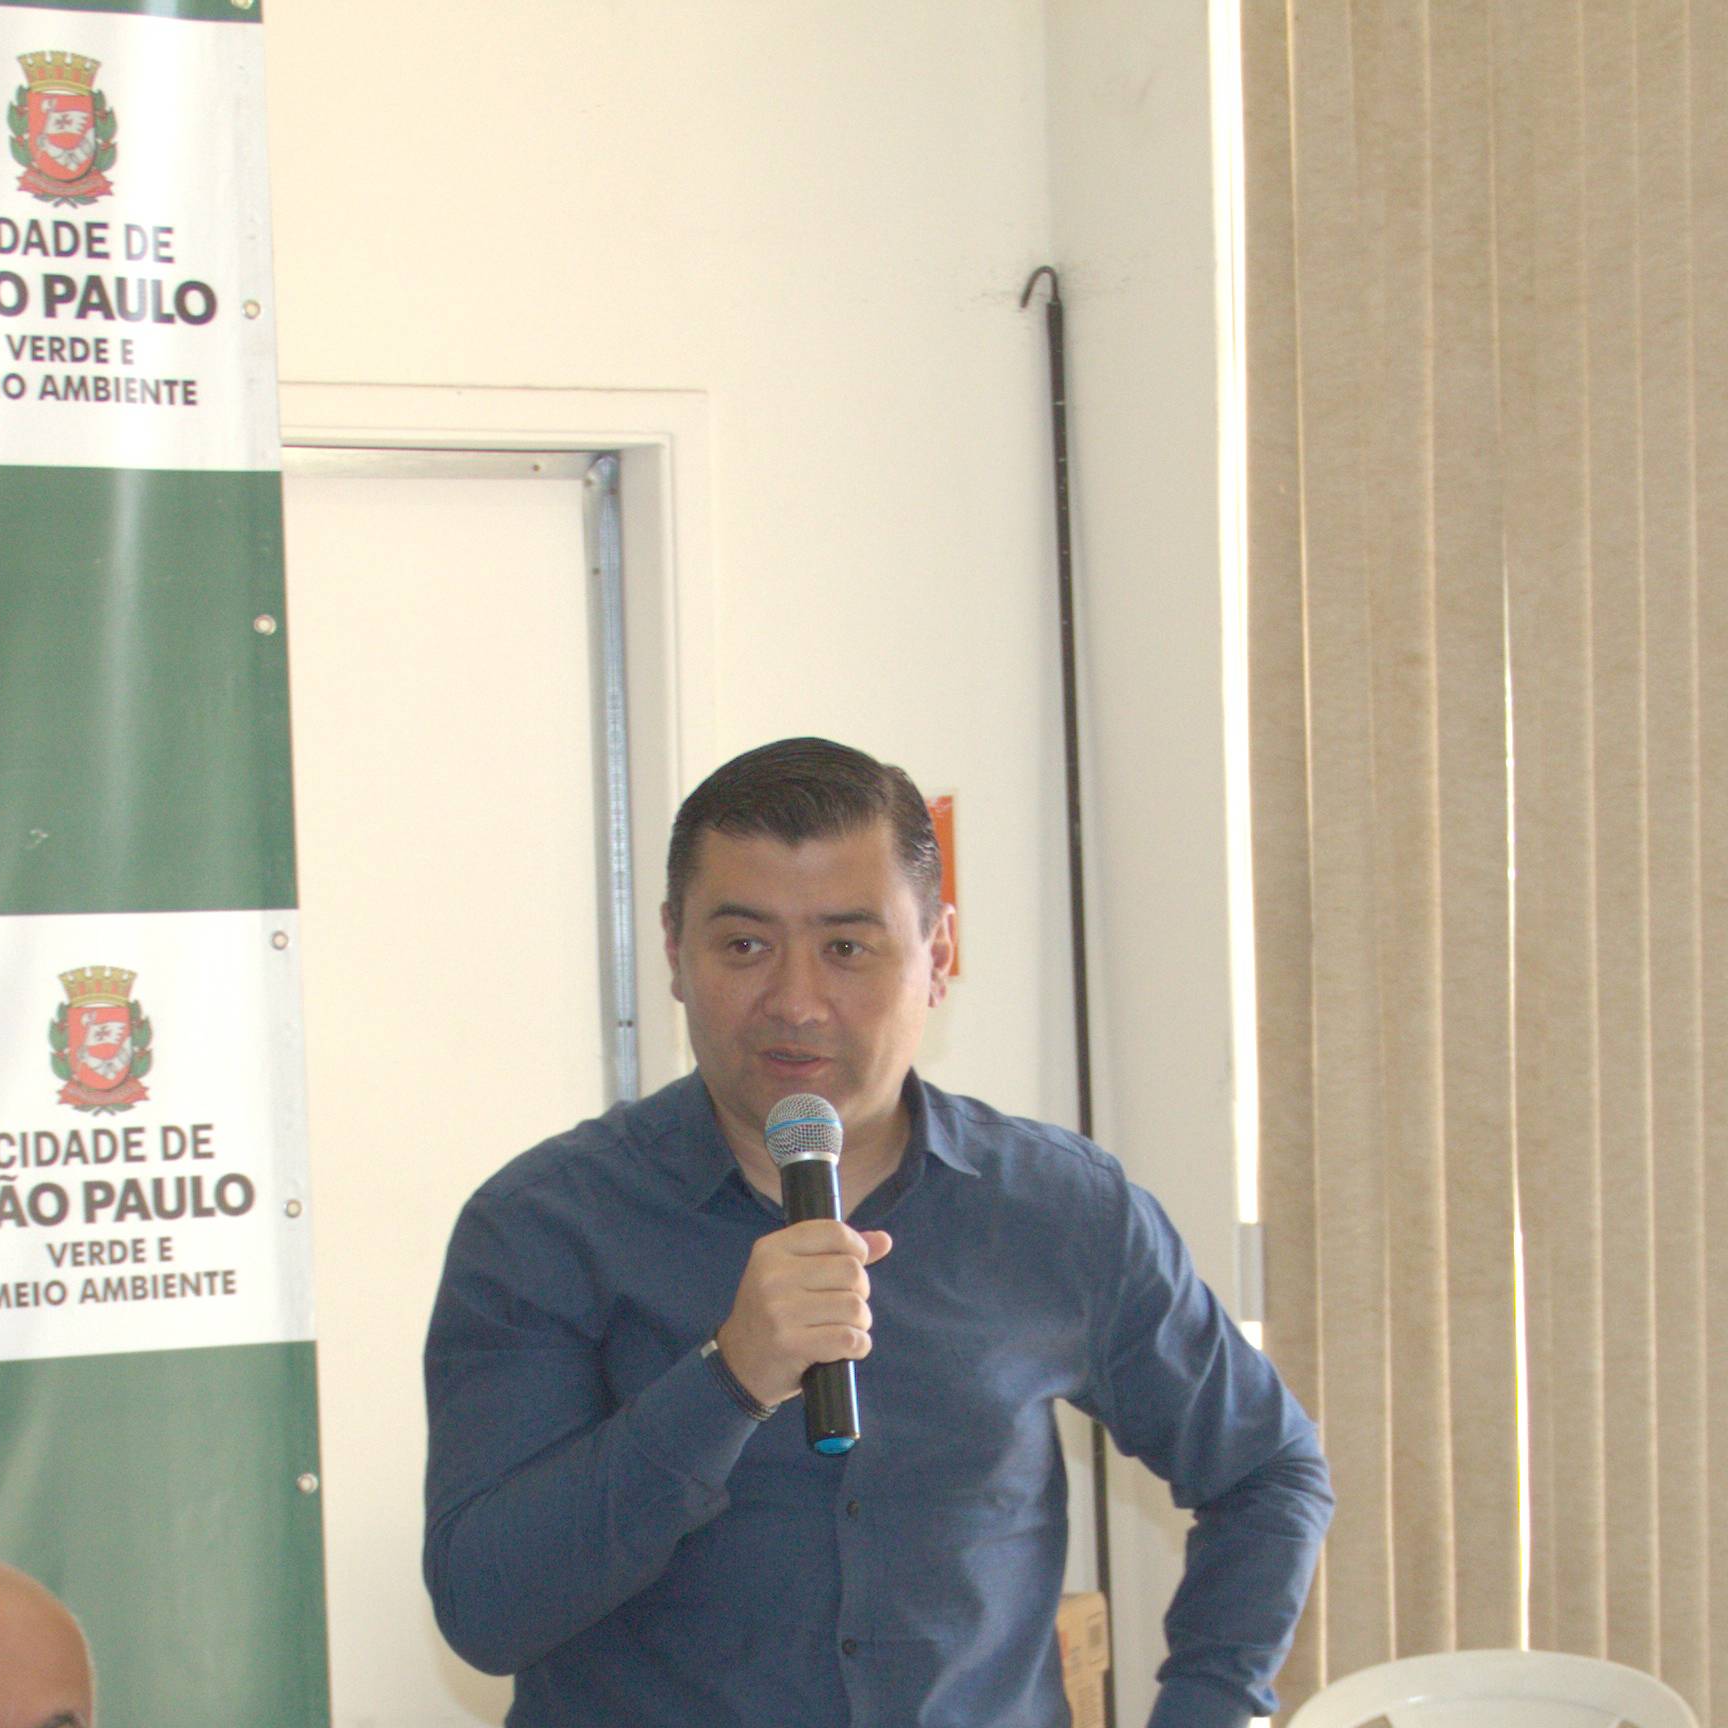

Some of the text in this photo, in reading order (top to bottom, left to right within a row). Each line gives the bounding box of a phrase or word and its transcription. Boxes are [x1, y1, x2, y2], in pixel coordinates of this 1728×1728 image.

[125, 224, 174, 263] DE
[43, 274, 217, 325] PAULO
[6, 335, 133, 364] VERDE E
[38, 374, 197, 405] AMBIENTE
[161, 1124, 214, 1161] DE
[83, 1173, 254, 1223] PAULO
[46, 1237, 172, 1267] VERDE E
[79, 1270, 235, 1304] AMBIENTE
